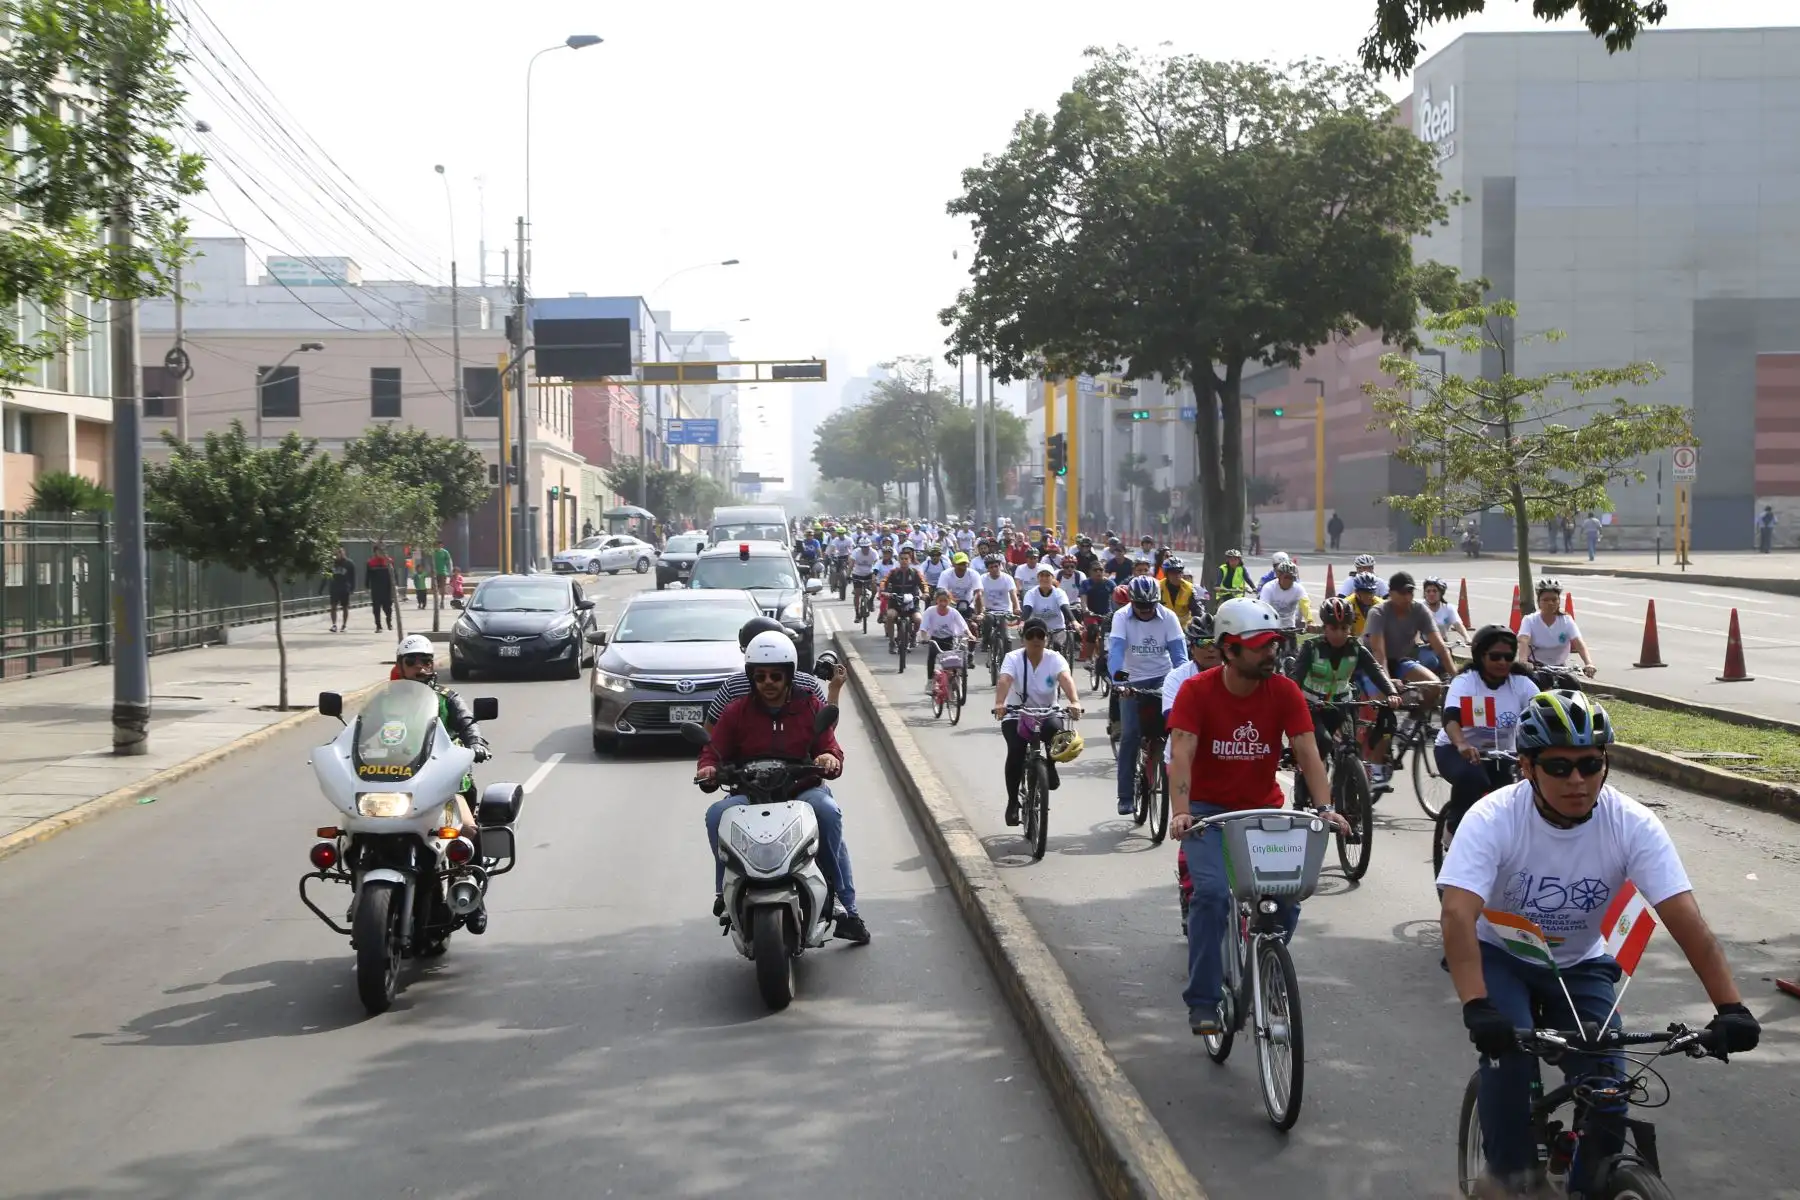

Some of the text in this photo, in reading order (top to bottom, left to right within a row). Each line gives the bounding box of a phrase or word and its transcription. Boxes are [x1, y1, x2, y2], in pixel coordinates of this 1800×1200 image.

[1420, 84, 1455, 142] Real
[359, 764, 413, 777] POLICIA
[1252, 844, 1302, 855] CityBikeLima
[1524, 911, 1556, 920] YEARS
